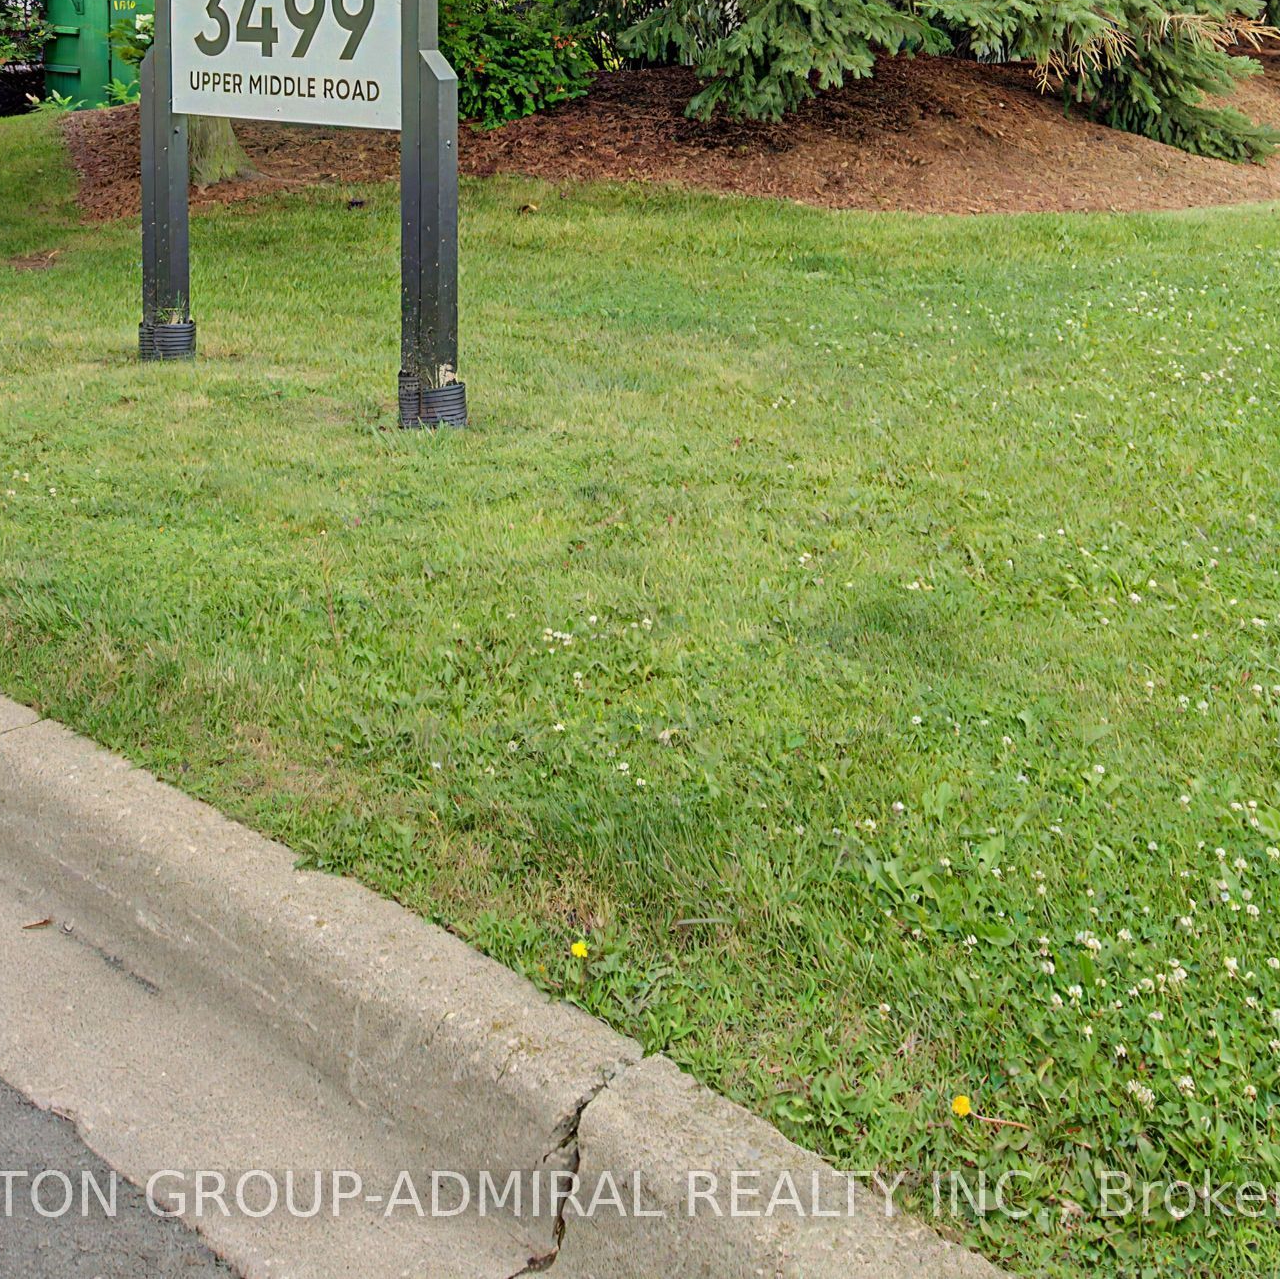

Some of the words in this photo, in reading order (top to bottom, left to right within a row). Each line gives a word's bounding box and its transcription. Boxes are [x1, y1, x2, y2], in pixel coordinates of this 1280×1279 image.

[189, 71, 243, 95] UPPER
[249, 74, 316, 99] MIDDLE
[323, 78, 380, 102] ROAD
